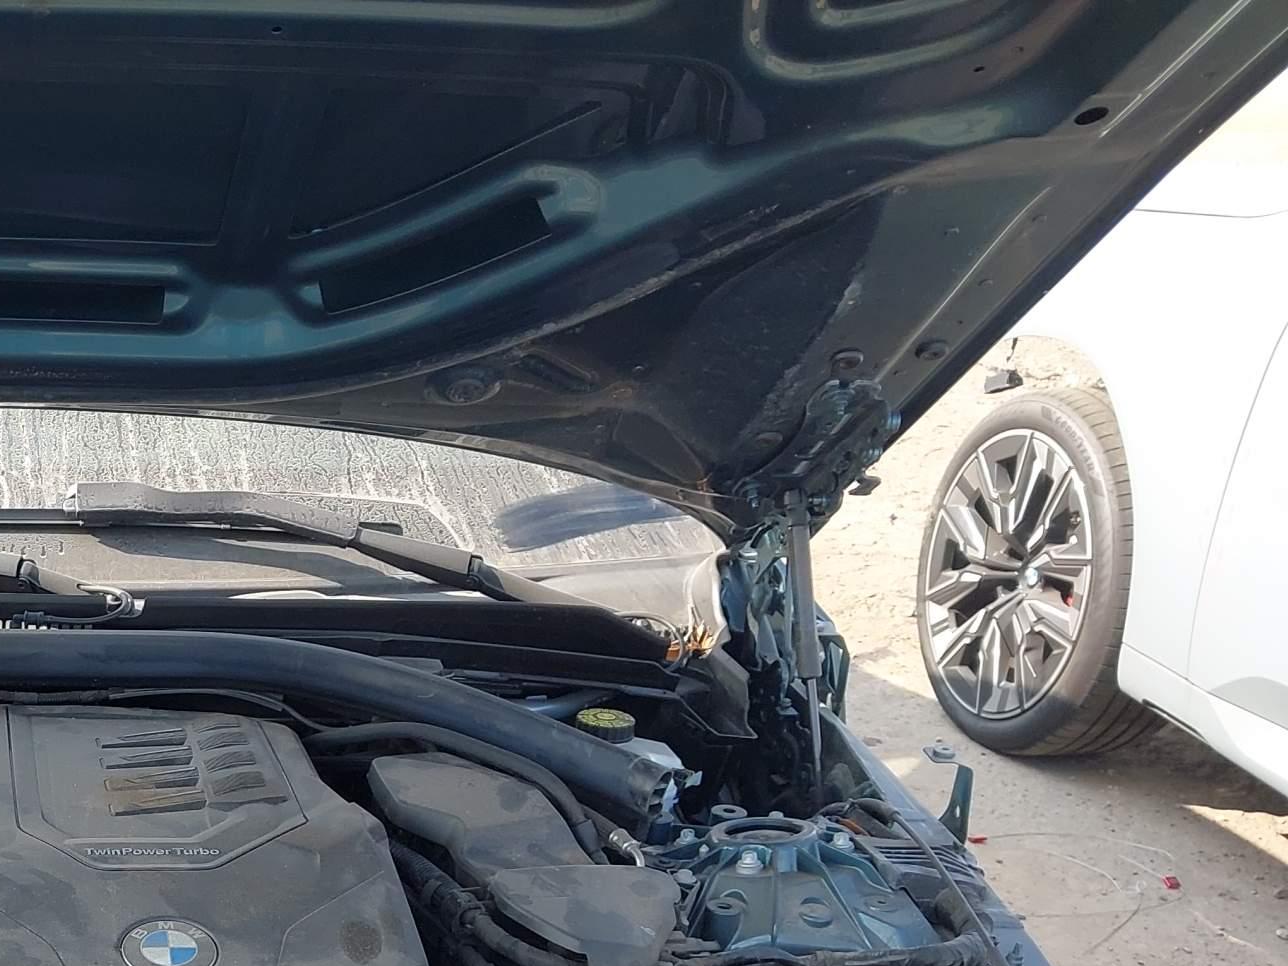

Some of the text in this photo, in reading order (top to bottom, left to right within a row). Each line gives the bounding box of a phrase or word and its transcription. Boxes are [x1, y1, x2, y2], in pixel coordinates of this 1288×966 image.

[85, 847, 220, 856] TwinPower Turbo
[131, 921, 206, 939] BMW
